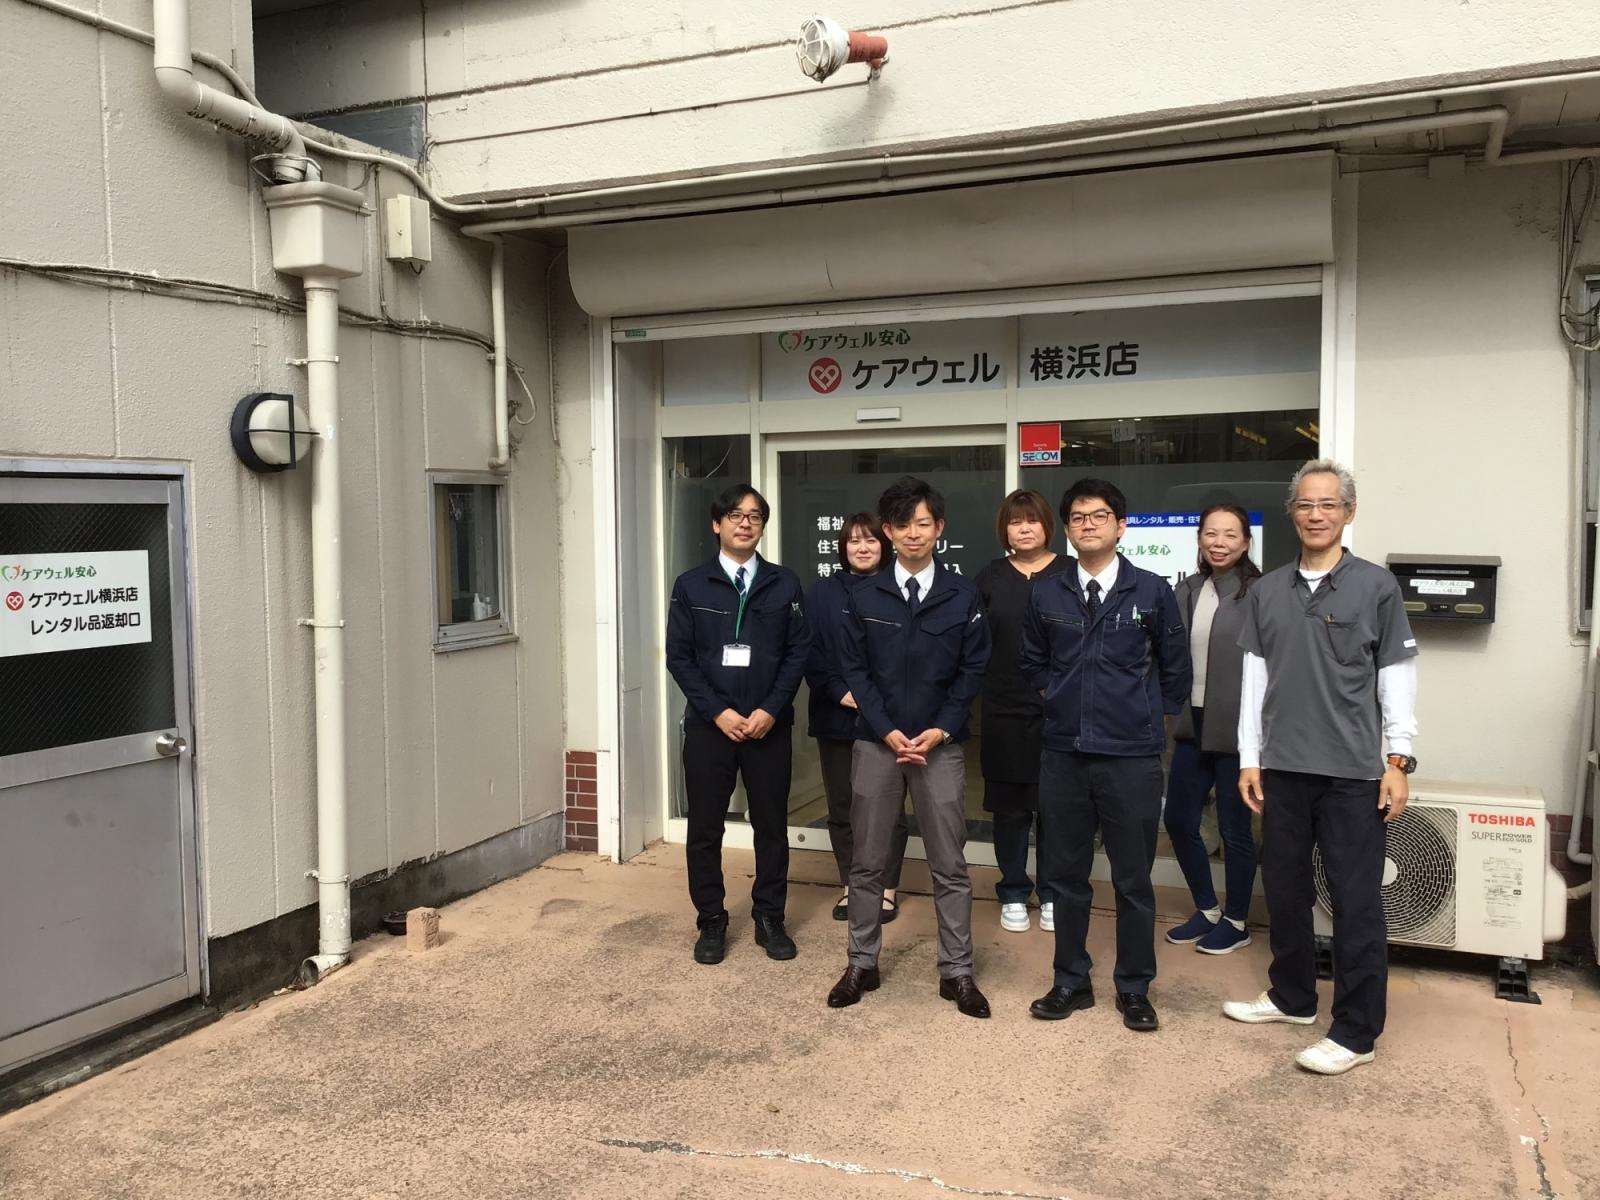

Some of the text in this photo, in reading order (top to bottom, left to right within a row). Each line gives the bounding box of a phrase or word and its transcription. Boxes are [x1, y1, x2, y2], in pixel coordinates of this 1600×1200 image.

[802, 328, 911, 351] ケアウェル安心
[852, 341, 1140, 390] ケアウェル 横浜店
[1022, 452, 1058, 462] SECOM
[21, 565, 97, 581] ケアウェル安心
[28, 587, 139, 609] ケアウェル横浜店
[31, 612, 141, 636] レンタル品返却口
[1468, 813, 1536, 827] TOSHIBA
[1471, 830, 1501, 841] SUPER
